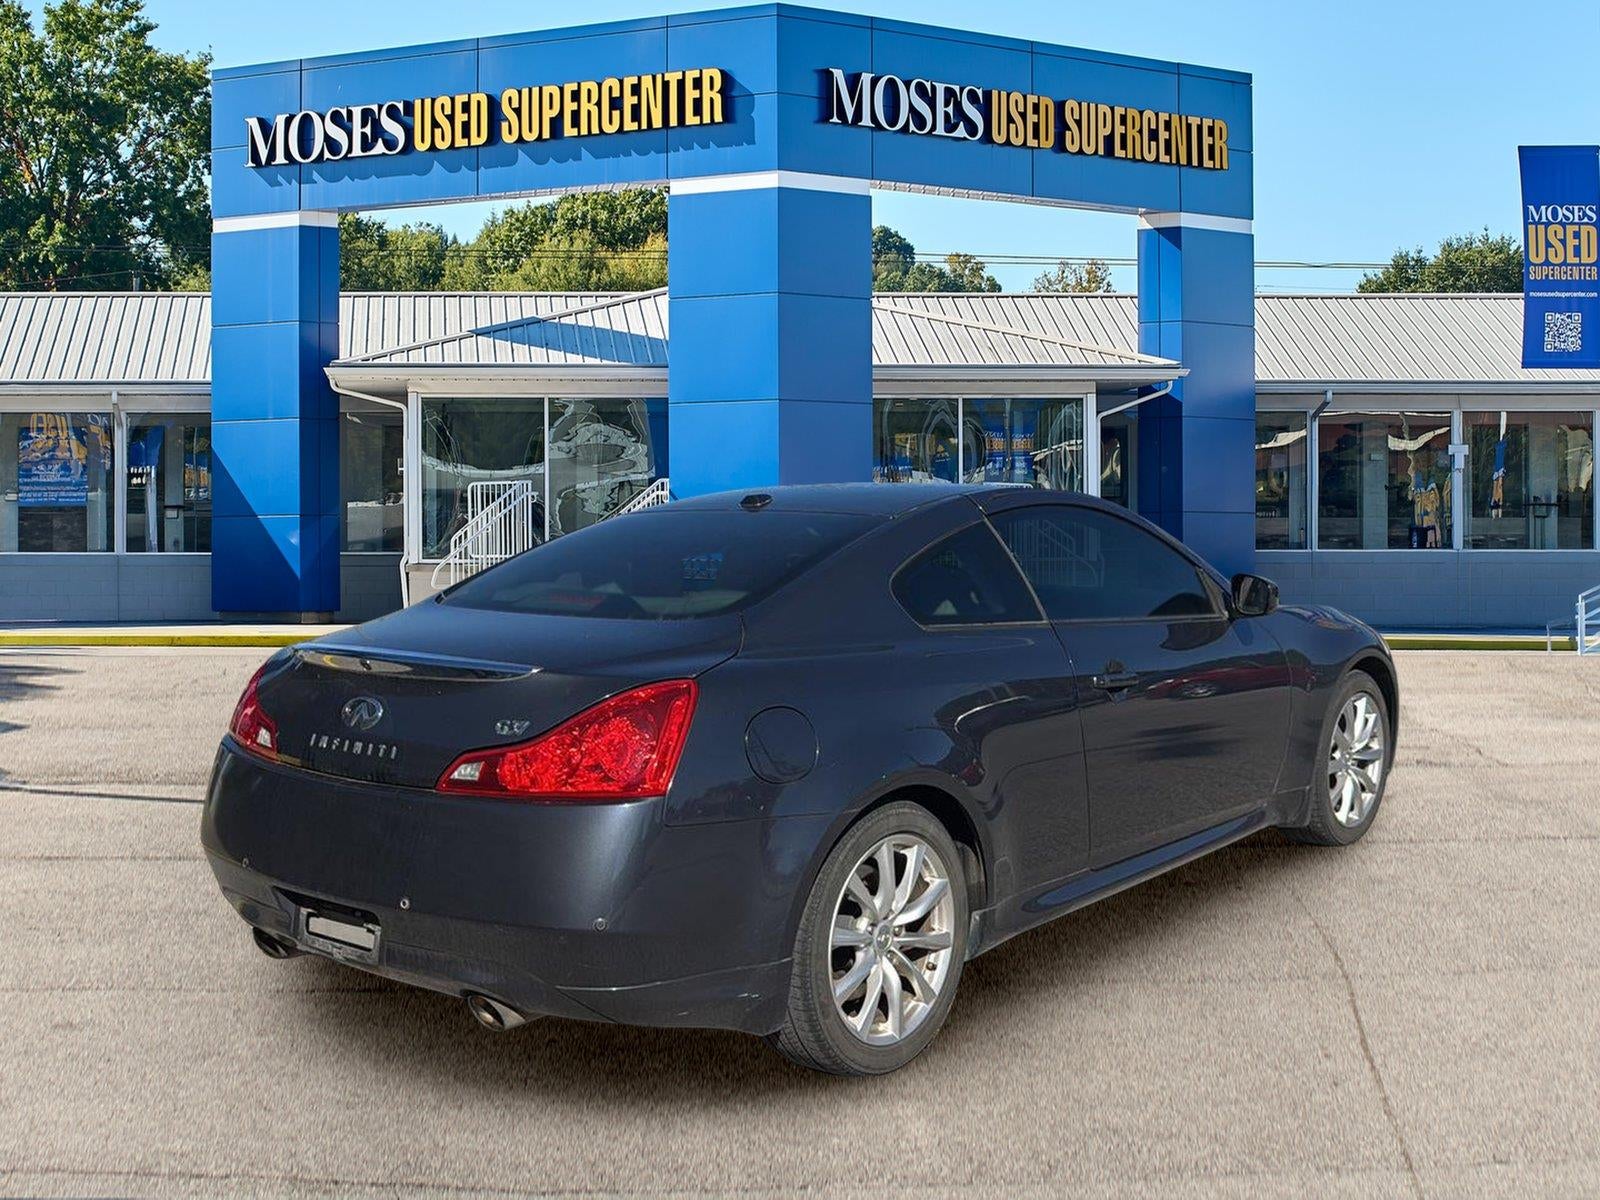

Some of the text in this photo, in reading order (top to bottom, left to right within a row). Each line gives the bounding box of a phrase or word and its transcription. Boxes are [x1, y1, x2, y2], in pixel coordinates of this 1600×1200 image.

[244, 67, 725, 169] MOSES USED SUPERCENTER
[828, 68, 1229, 170] MOSES USED SUPERCENTER
[1527, 204, 1597, 223] MOSES
[1528, 225, 1598, 264] USED
[1529, 265, 1598, 281] SUPERCENTER
[309, 732, 398, 760] INFINITI
